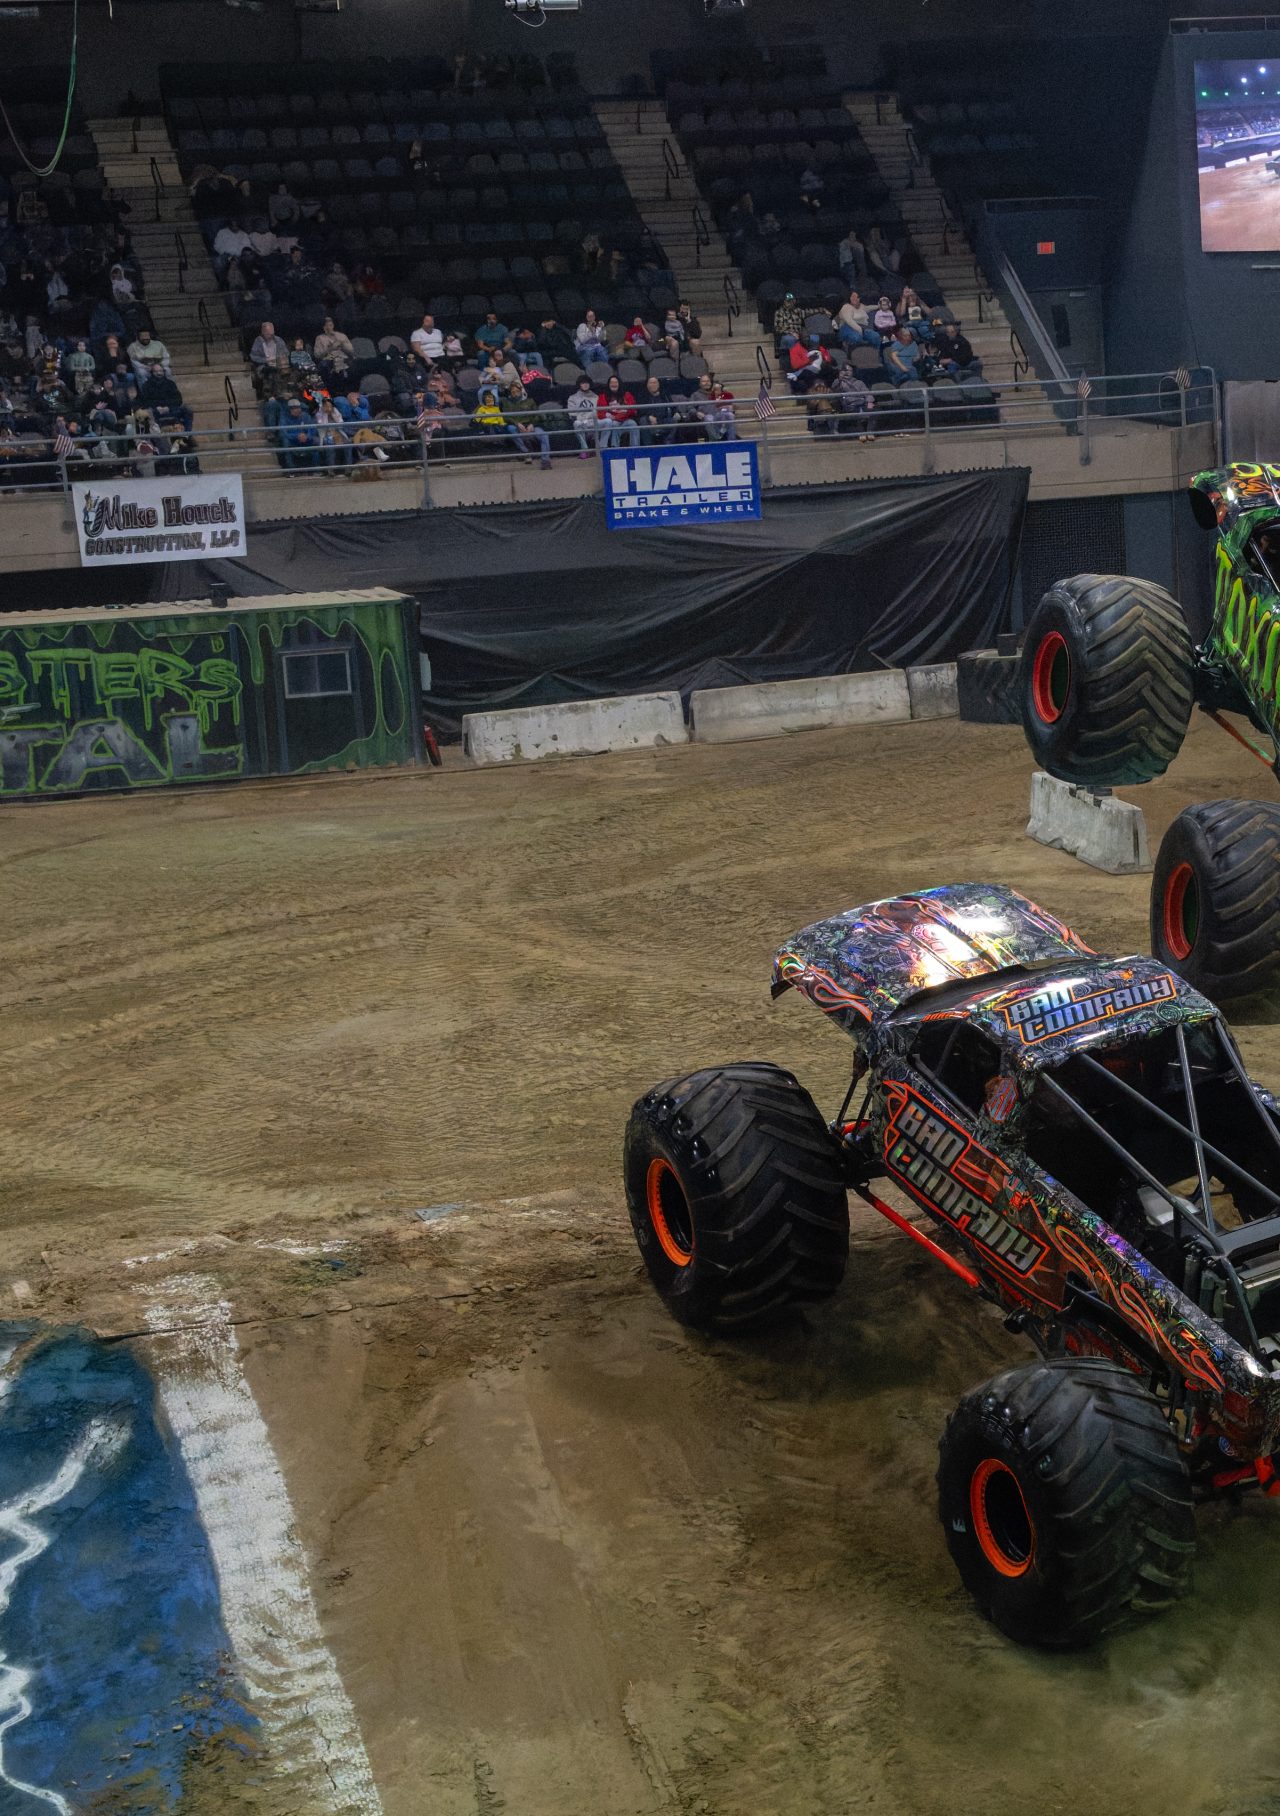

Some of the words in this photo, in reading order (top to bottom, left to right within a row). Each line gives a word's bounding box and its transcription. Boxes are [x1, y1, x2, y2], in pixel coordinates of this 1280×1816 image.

[609, 451, 752, 493] HALE
[84, 494, 158, 538] Mike
[162, 495, 237, 527] Houck
[614, 509, 669, 520] BRAKE
[700, 504, 754, 514] WHEEL
[615, 490, 751, 508] TRAILER
[85, 531, 206, 556] CONSTRUCTION,
[209, 529, 241, 548] LLC
[1009, 986, 1071, 1023] BAD
[1023, 979, 1172, 1041] COMPANY
[896, 1101, 966, 1168] BAD
[888, 1139, 1042, 1272] COMPANY
